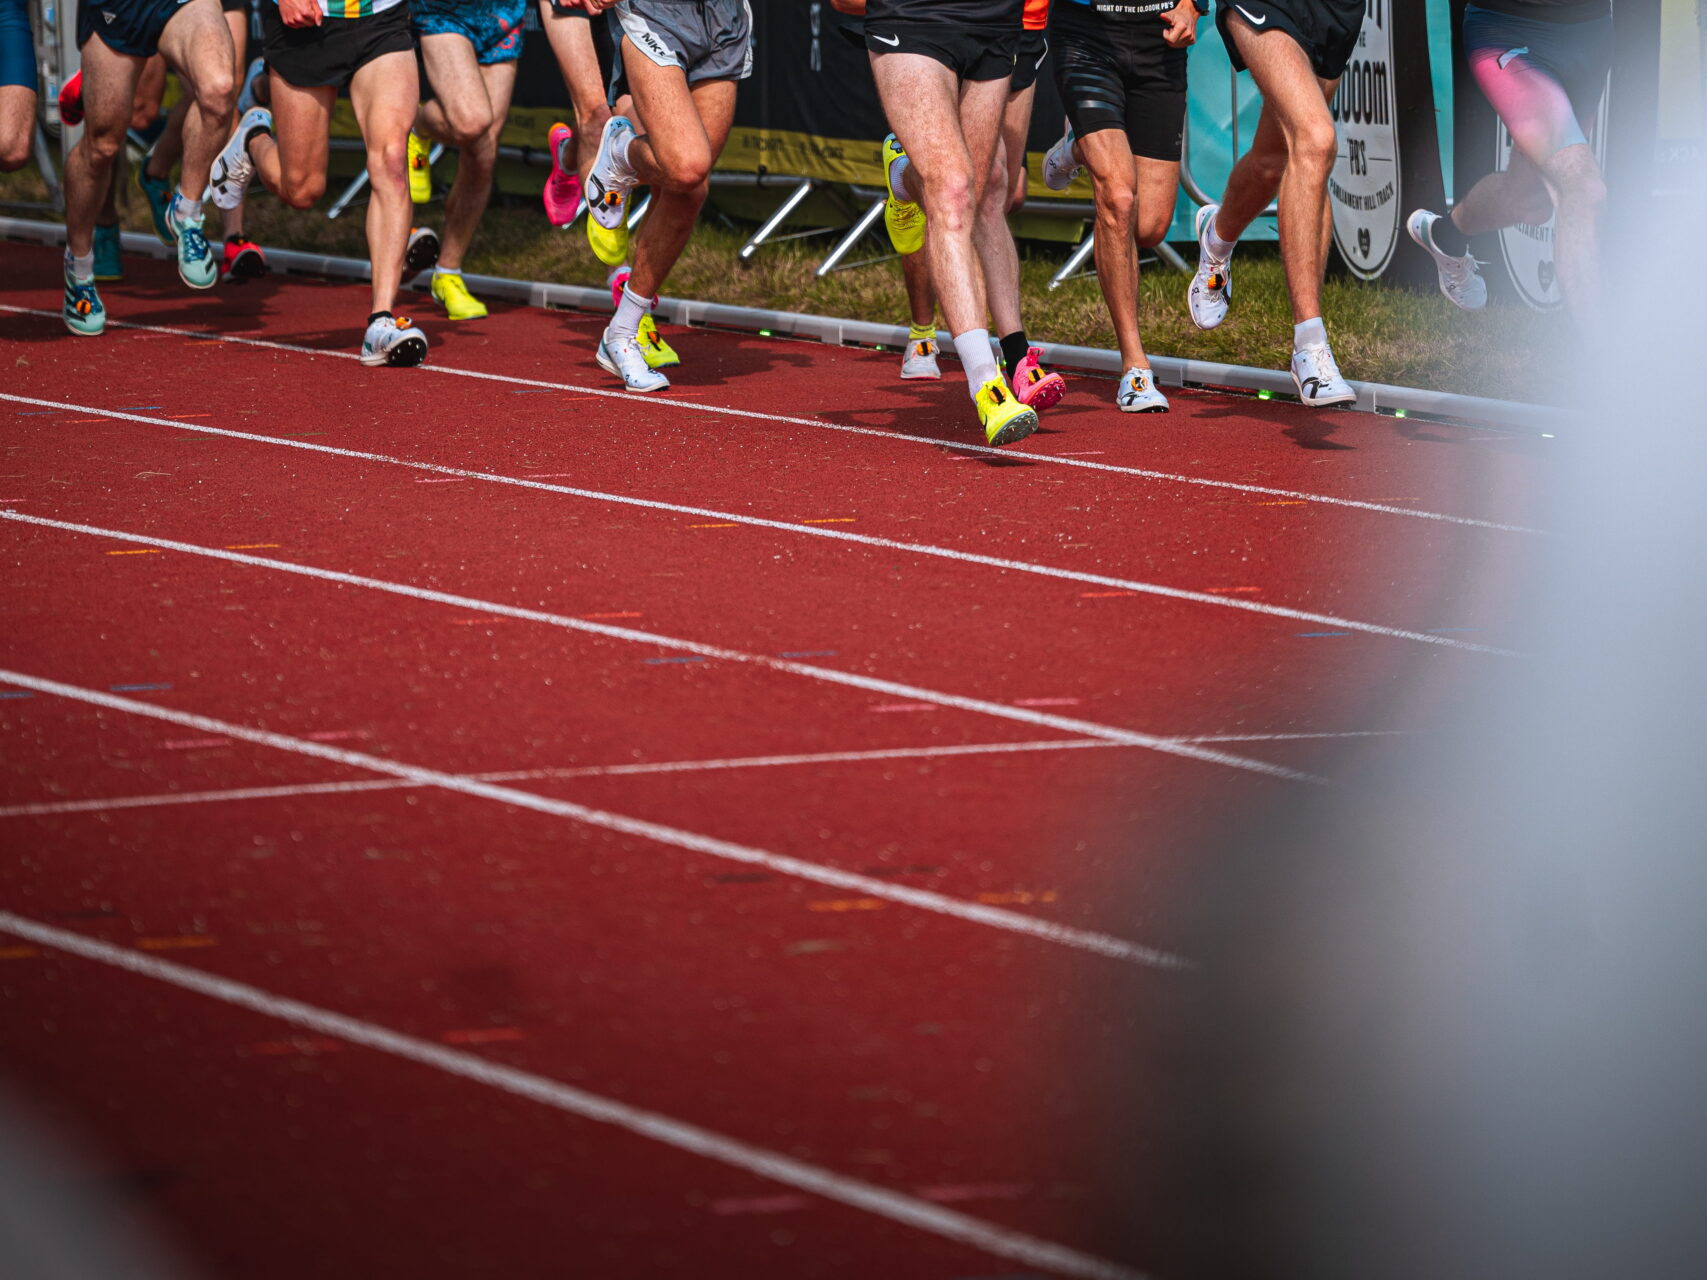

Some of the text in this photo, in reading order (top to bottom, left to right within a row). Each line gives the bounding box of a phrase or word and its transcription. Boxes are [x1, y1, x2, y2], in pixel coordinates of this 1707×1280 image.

[1096, 4, 1114, 12] NIGHT
[1115, 4, 1123, 12] OF
[641, 32, 666, 56] NIKE
[1330, 177, 1394, 211] PARLIAMENT HILL TRACK
